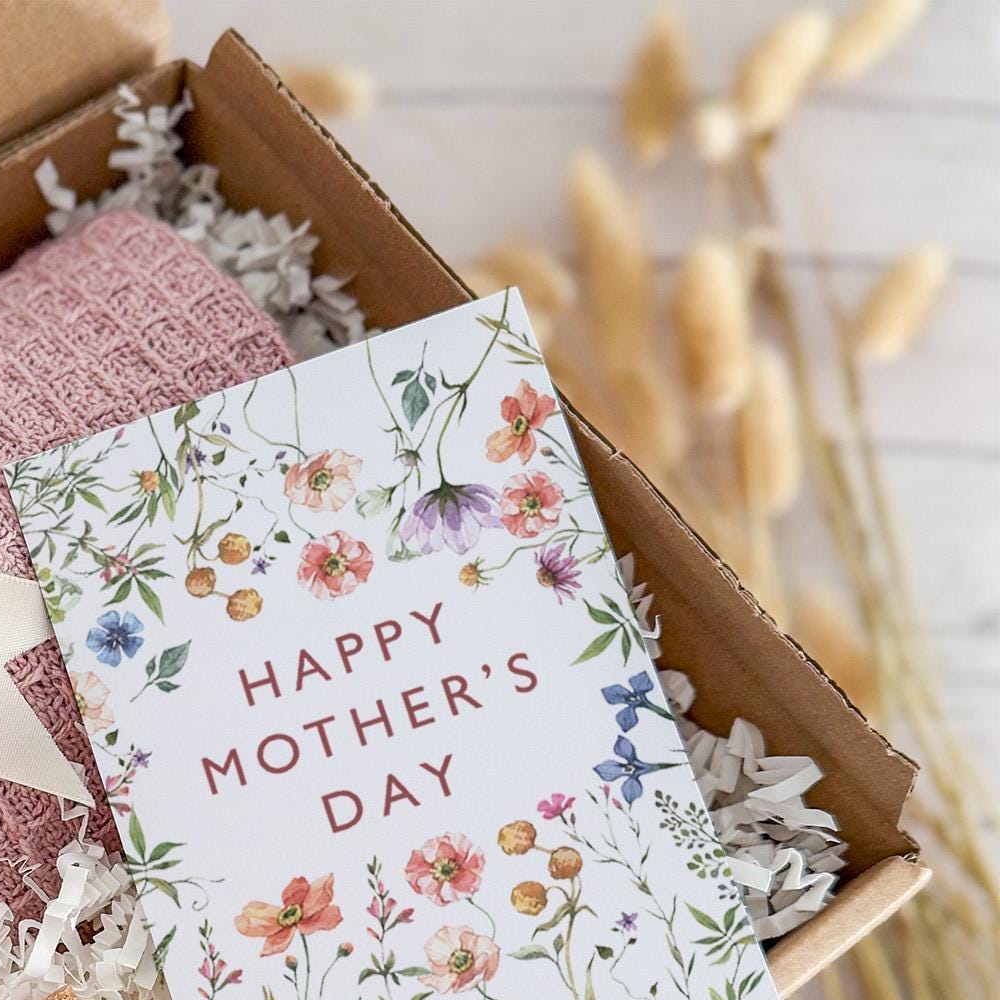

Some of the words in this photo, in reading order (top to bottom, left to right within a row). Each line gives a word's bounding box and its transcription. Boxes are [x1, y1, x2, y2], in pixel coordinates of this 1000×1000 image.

[238, 602, 443, 707] HAPPY
[201, 652, 538, 795] MOTHER’S
[321, 753, 453, 834] DAY
